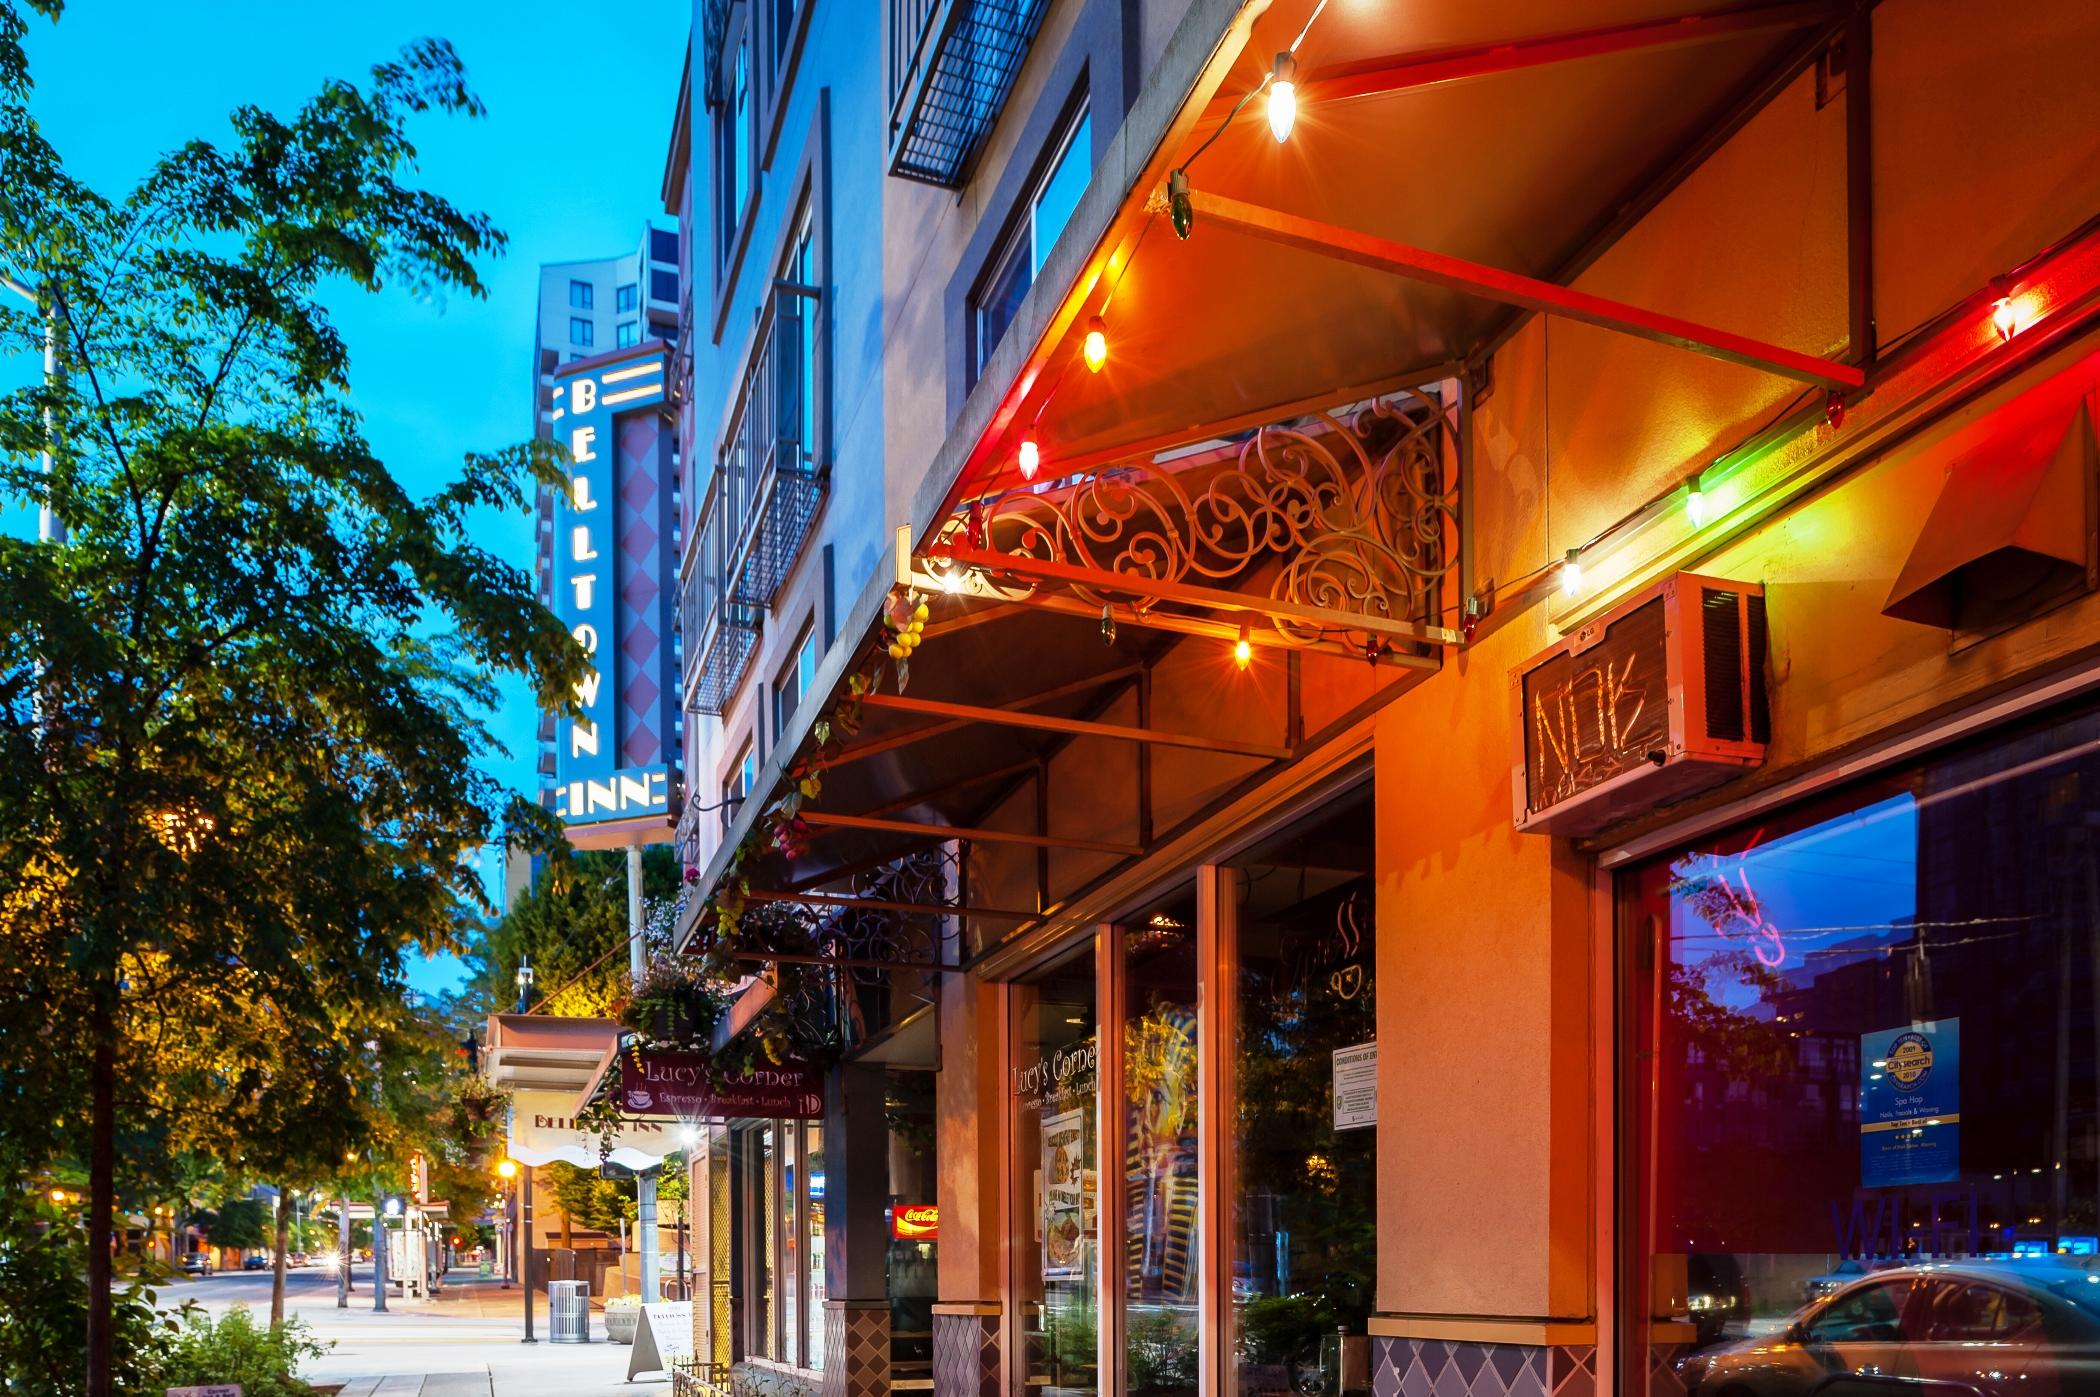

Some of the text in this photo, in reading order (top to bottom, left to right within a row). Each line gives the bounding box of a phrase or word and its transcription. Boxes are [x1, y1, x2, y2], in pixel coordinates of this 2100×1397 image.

[571, 379, 599, 758] BELLTOWN
[1586, 628, 1595, 636] LG
[571, 772, 650, 817] INN
[1902, 1045, 1916, 1054] 2009
[1888, 1055, 1930, 1070] Citysearch
[646, 1060, 713, 1086] Lucy's
[1012, 1057, 1048, 1095] Lucy's
[1902, 1071, 1917, 1080] 2010
[659, 1093, 791, 1107] Espresso Breakfast Lunch
[1895, 1095, 1924, 1107] Spa Hop
[633, 1121, 662, 1133] INN
